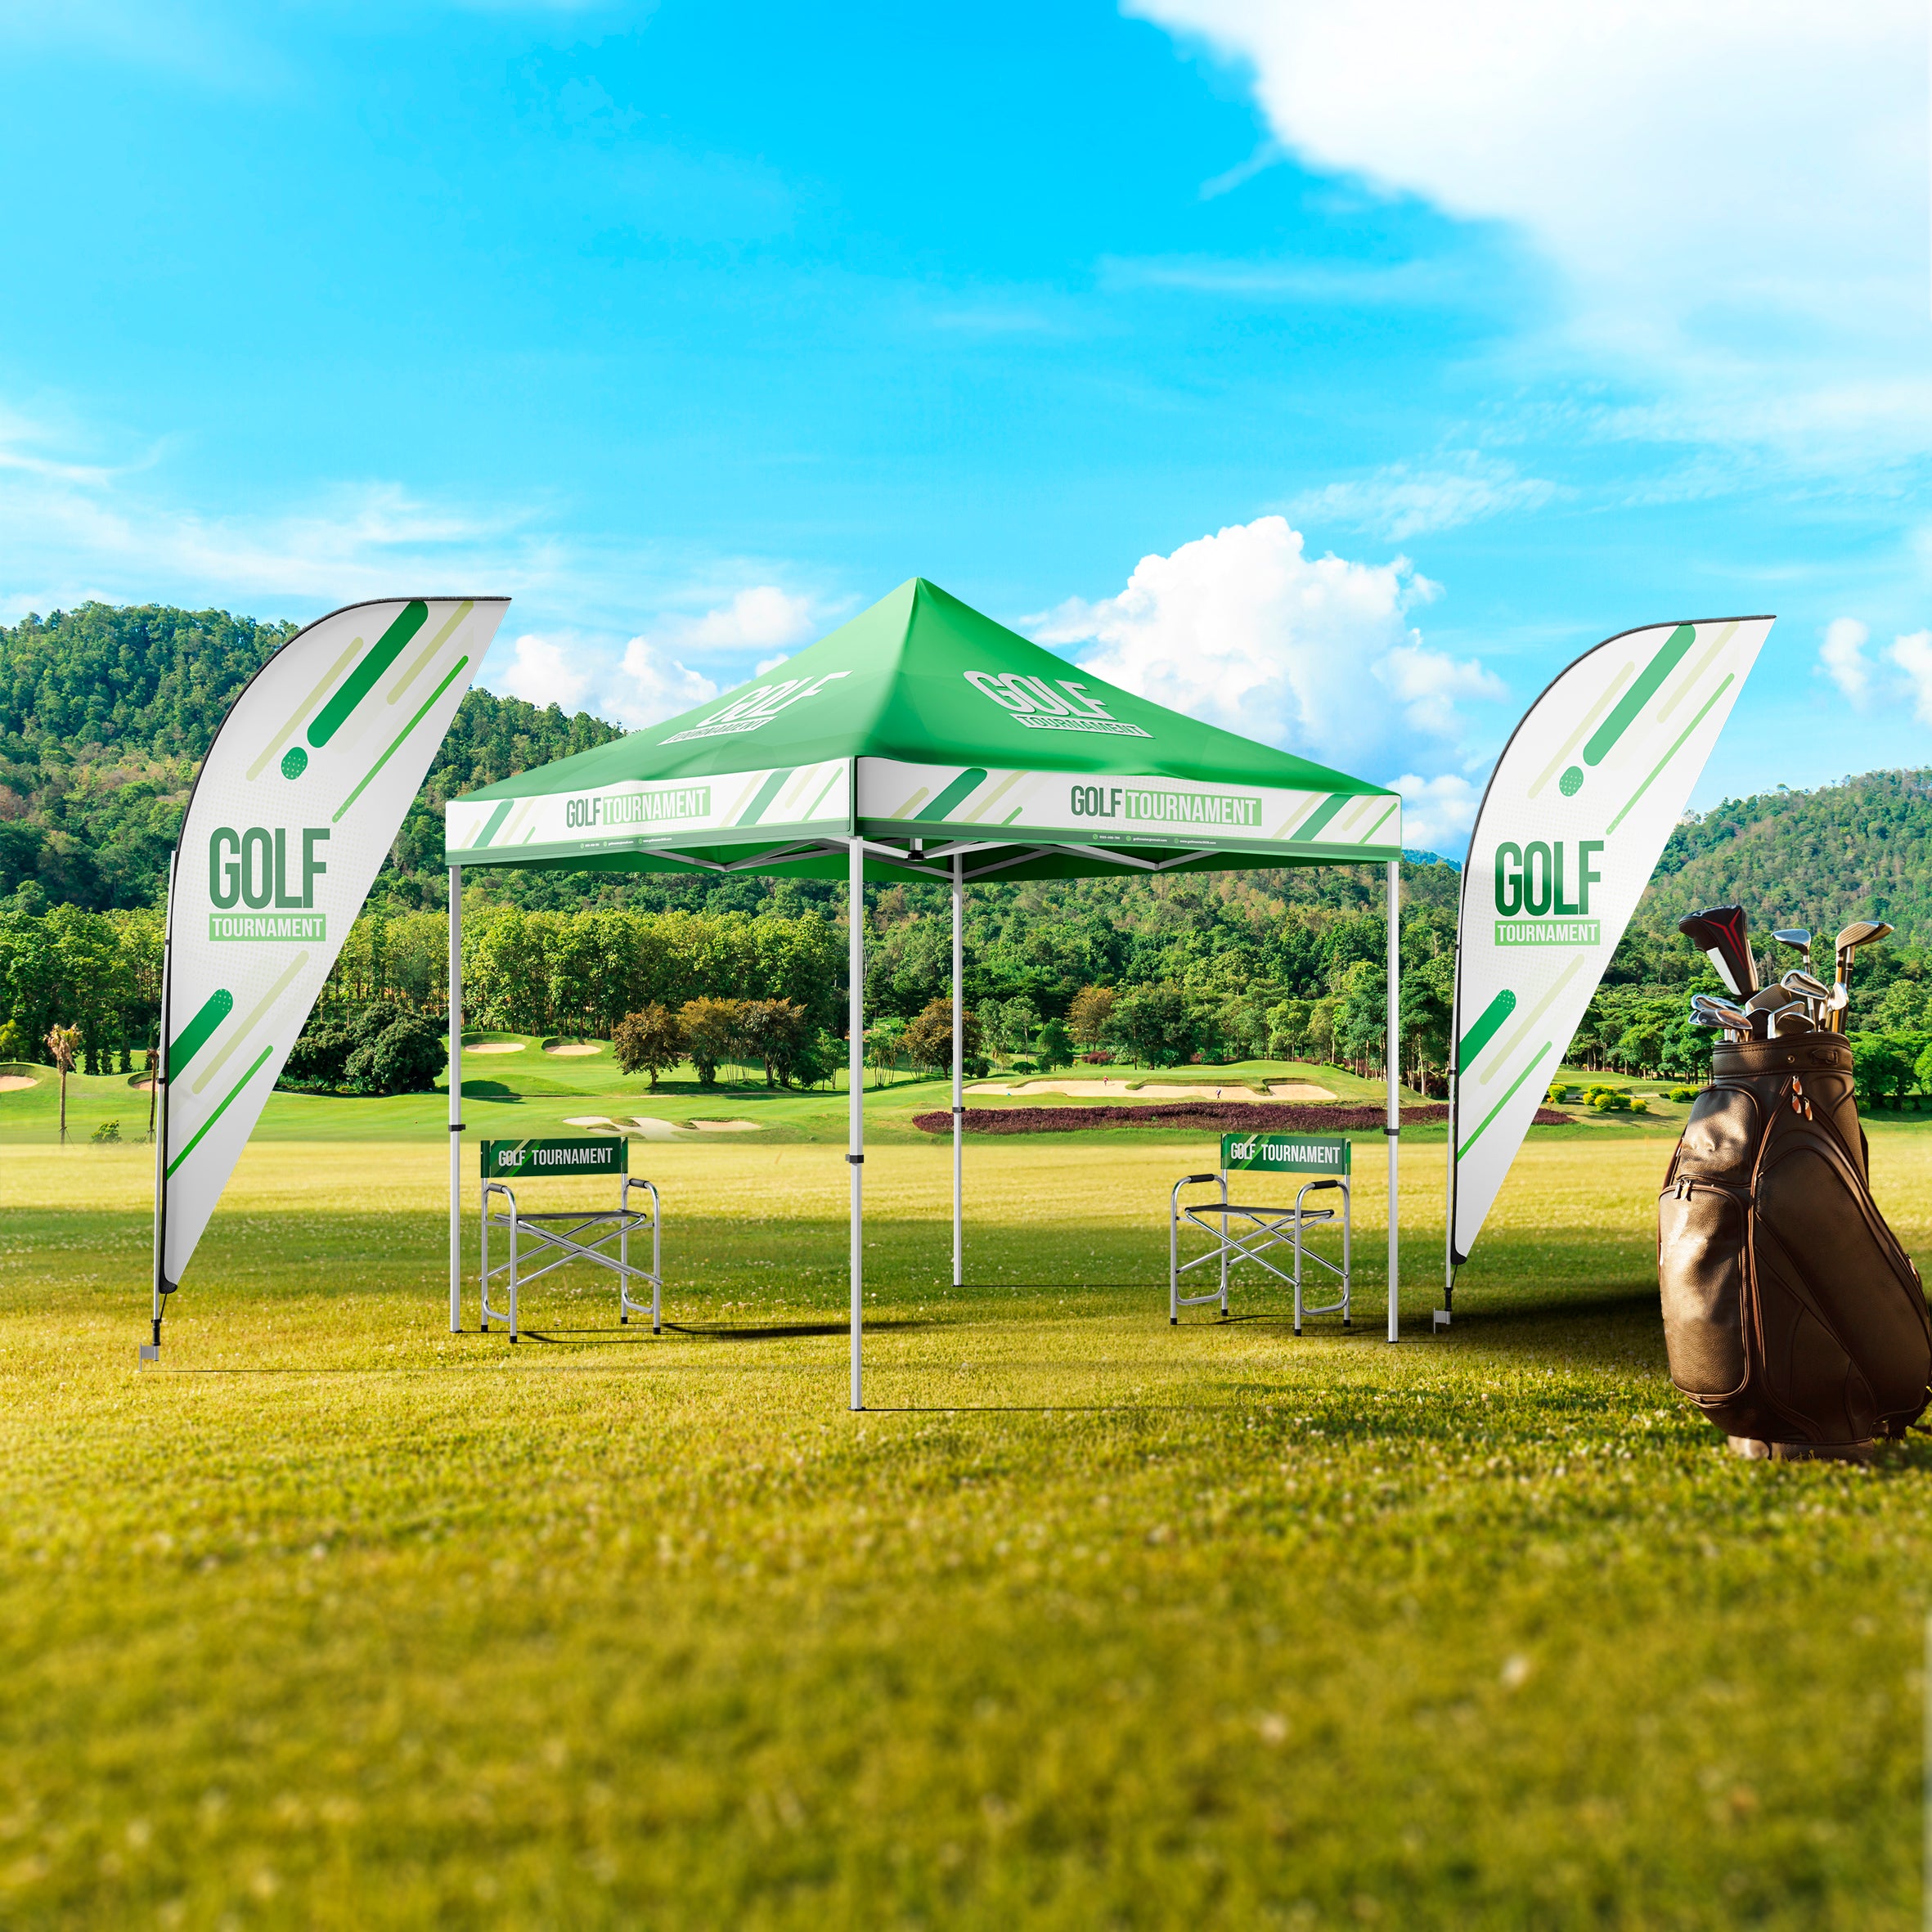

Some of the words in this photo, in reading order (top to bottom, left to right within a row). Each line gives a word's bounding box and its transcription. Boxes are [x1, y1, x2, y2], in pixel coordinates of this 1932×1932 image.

[695, 670, 853, 727] GOLF
[964, 671, 1117, 721] GOLF
[1017, 716, 1143, 735] TOURNAMENT
[566, 797, 601, 828] GOLF
[604, 789, 706, 823] TOURNAMENT
[1071, 785, 1122, 817] GOLF
[1127, 792, 1256, 824] TOURNAMENT
[209, 827, 330, 910] GOLF
[1495, 840, 1604, 917] GOLF
[212, 918, 323, 937] TOURNAMENT
[1498, 923, 1597, 942] TOURNAMENT
[498, 1150, 526, 1166] GOLF
[532, 1148, 613, 1166] TOURNAMENT
[1230, 1142, 1256, 1160] GOLF
[1260, 1143, 1340, 1164] TOURNAMENT
